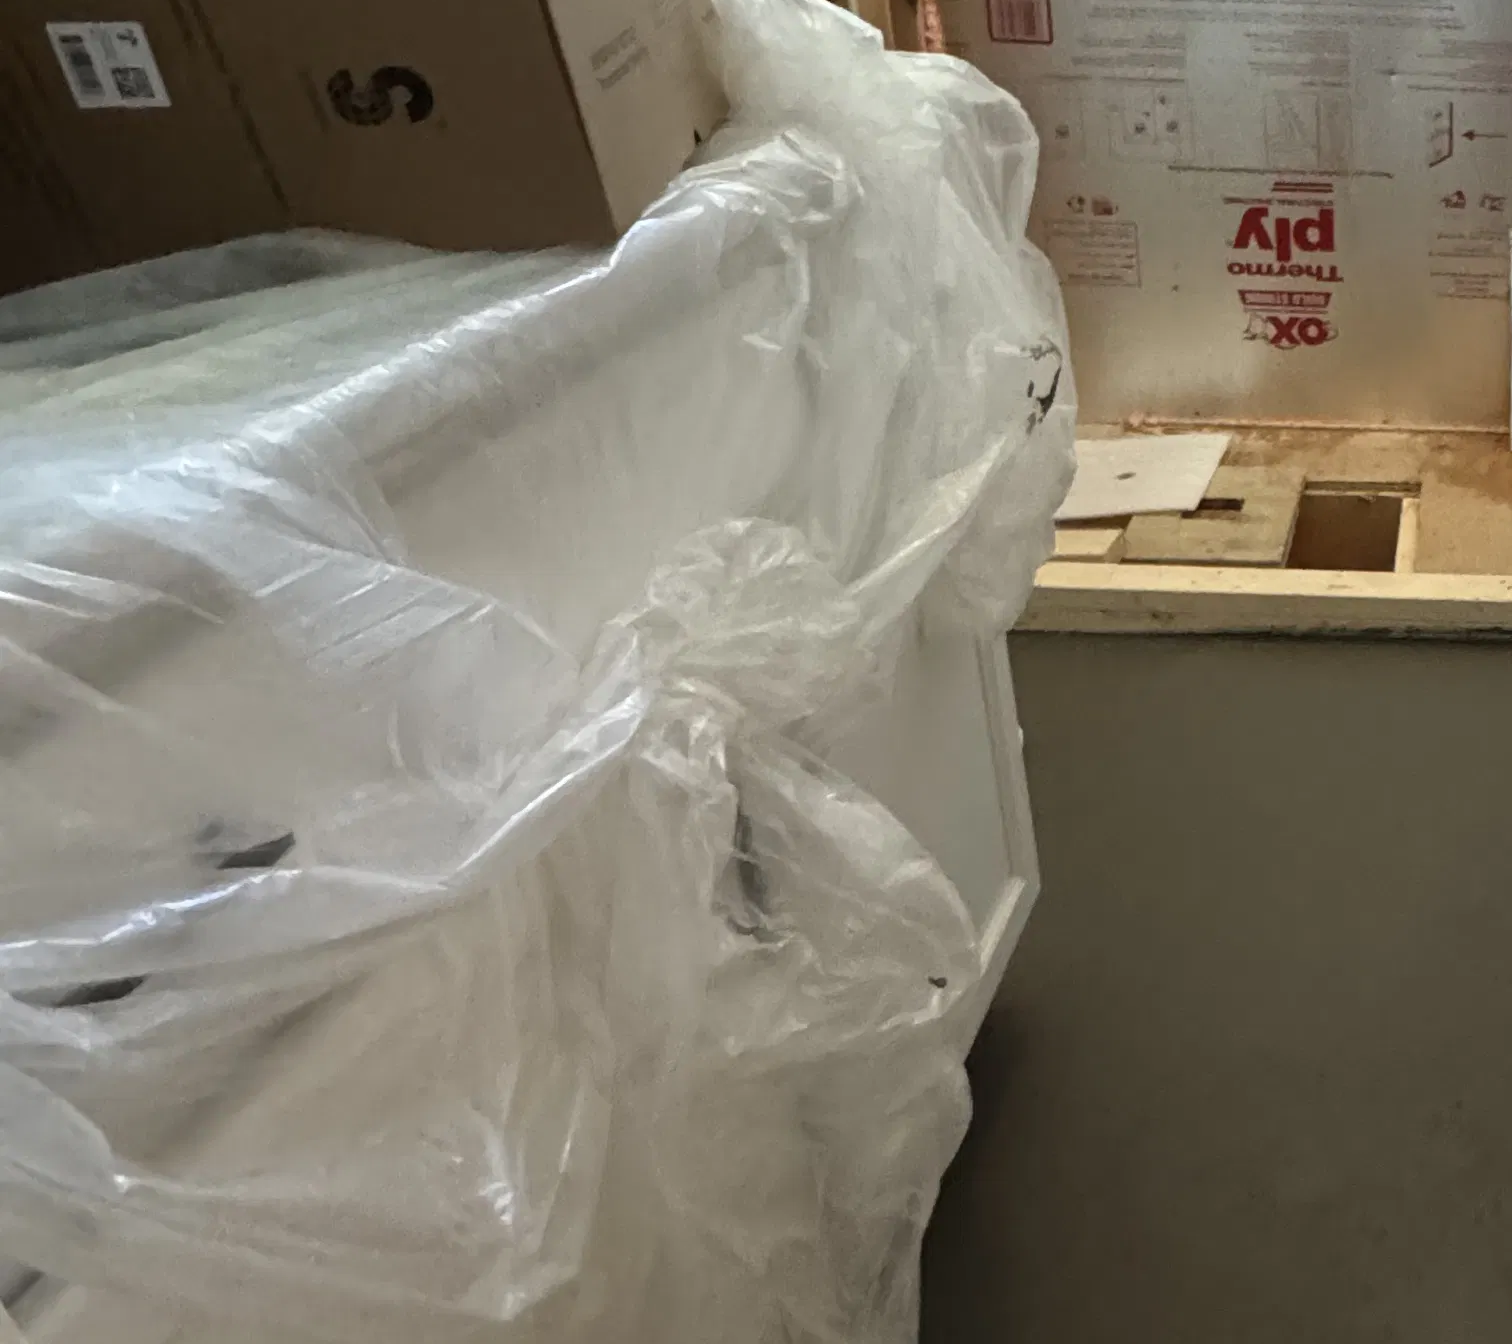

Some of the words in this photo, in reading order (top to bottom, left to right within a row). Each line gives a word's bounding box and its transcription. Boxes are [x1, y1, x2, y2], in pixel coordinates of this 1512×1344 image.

[1232, 207, 1335, 262] ply
[1227, 262, 1344, 282] Thermo
[1266, 316, 1328, 346] OX
